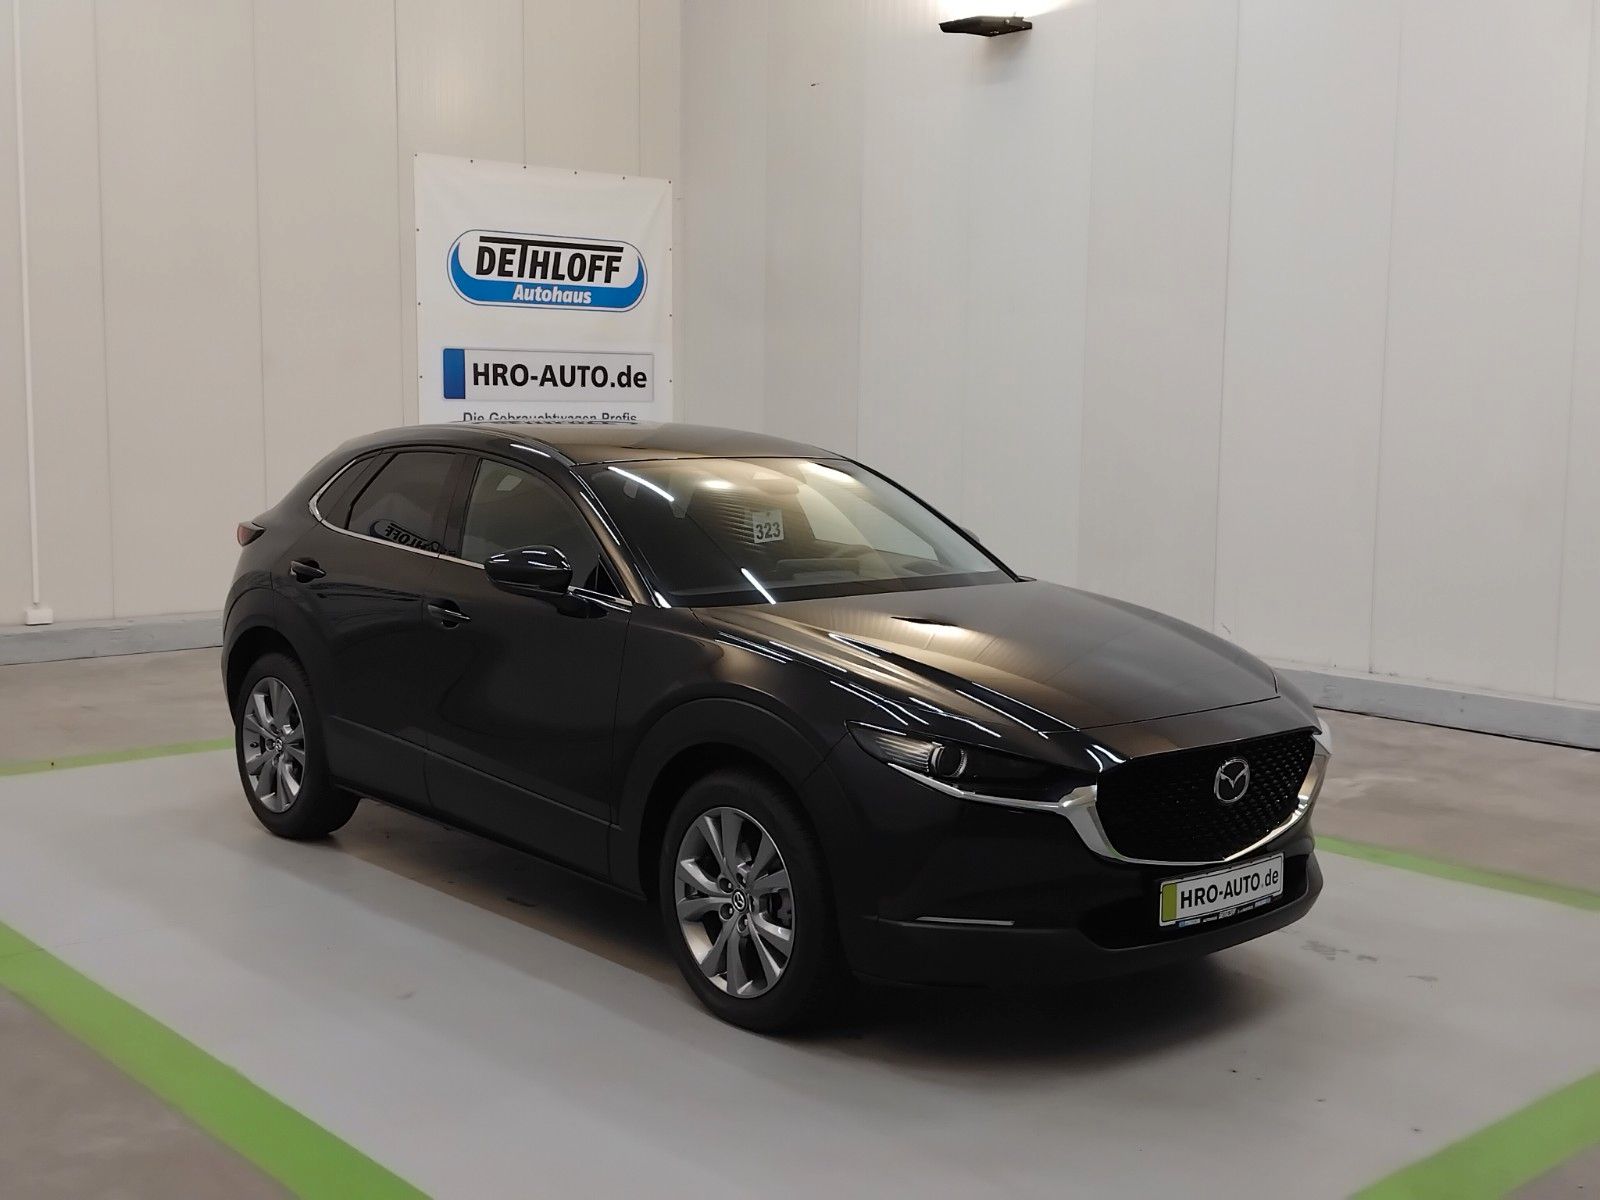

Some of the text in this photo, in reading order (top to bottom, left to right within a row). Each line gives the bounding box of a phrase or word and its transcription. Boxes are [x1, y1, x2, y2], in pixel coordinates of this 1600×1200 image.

[475, 235, 625, 284] DETHLOFF
[512, 284, 592, 305] Autohaus
[473, 363, 648, 389] HRO-AUTO.de
[755, 522, 781, 540] 323
[1180, 868, 1279, 909] HRO-AUTO.de
